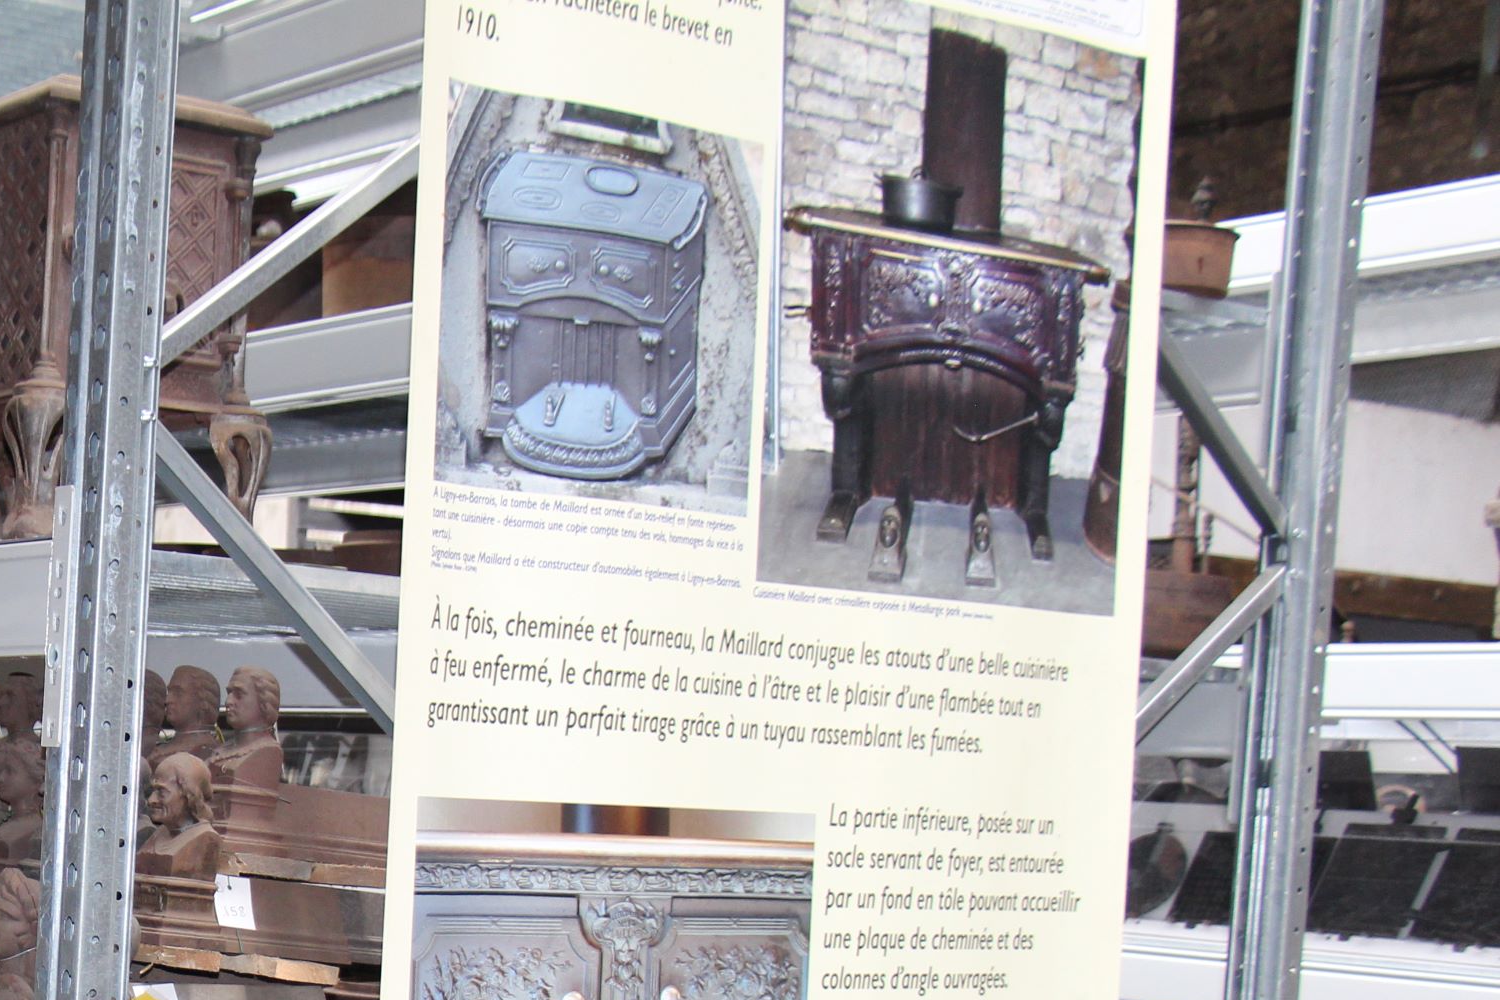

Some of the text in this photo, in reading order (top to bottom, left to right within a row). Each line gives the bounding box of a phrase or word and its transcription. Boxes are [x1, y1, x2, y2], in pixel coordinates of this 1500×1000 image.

[456, 4, 500, 42] 1910.
[662, 5, 710, 41] brevet
[714, 25, 734, 46] en
[431, 603, 1069, 682] À la fois, cheminée et fourneau, la Maillard conjugue les atouts d'une belle cuisinière
[430, 649, 1041, 718] à feu enfermé, le charme de la cuisine à l'âtre et le plaisir d'une flambée tout en
[427, 699, 983, 756] garantissant un parfait tirage grâce à un tuyau rassemblant les fumées.
[829, 803, 1054, 835] La partie inférieure, posée sur un
